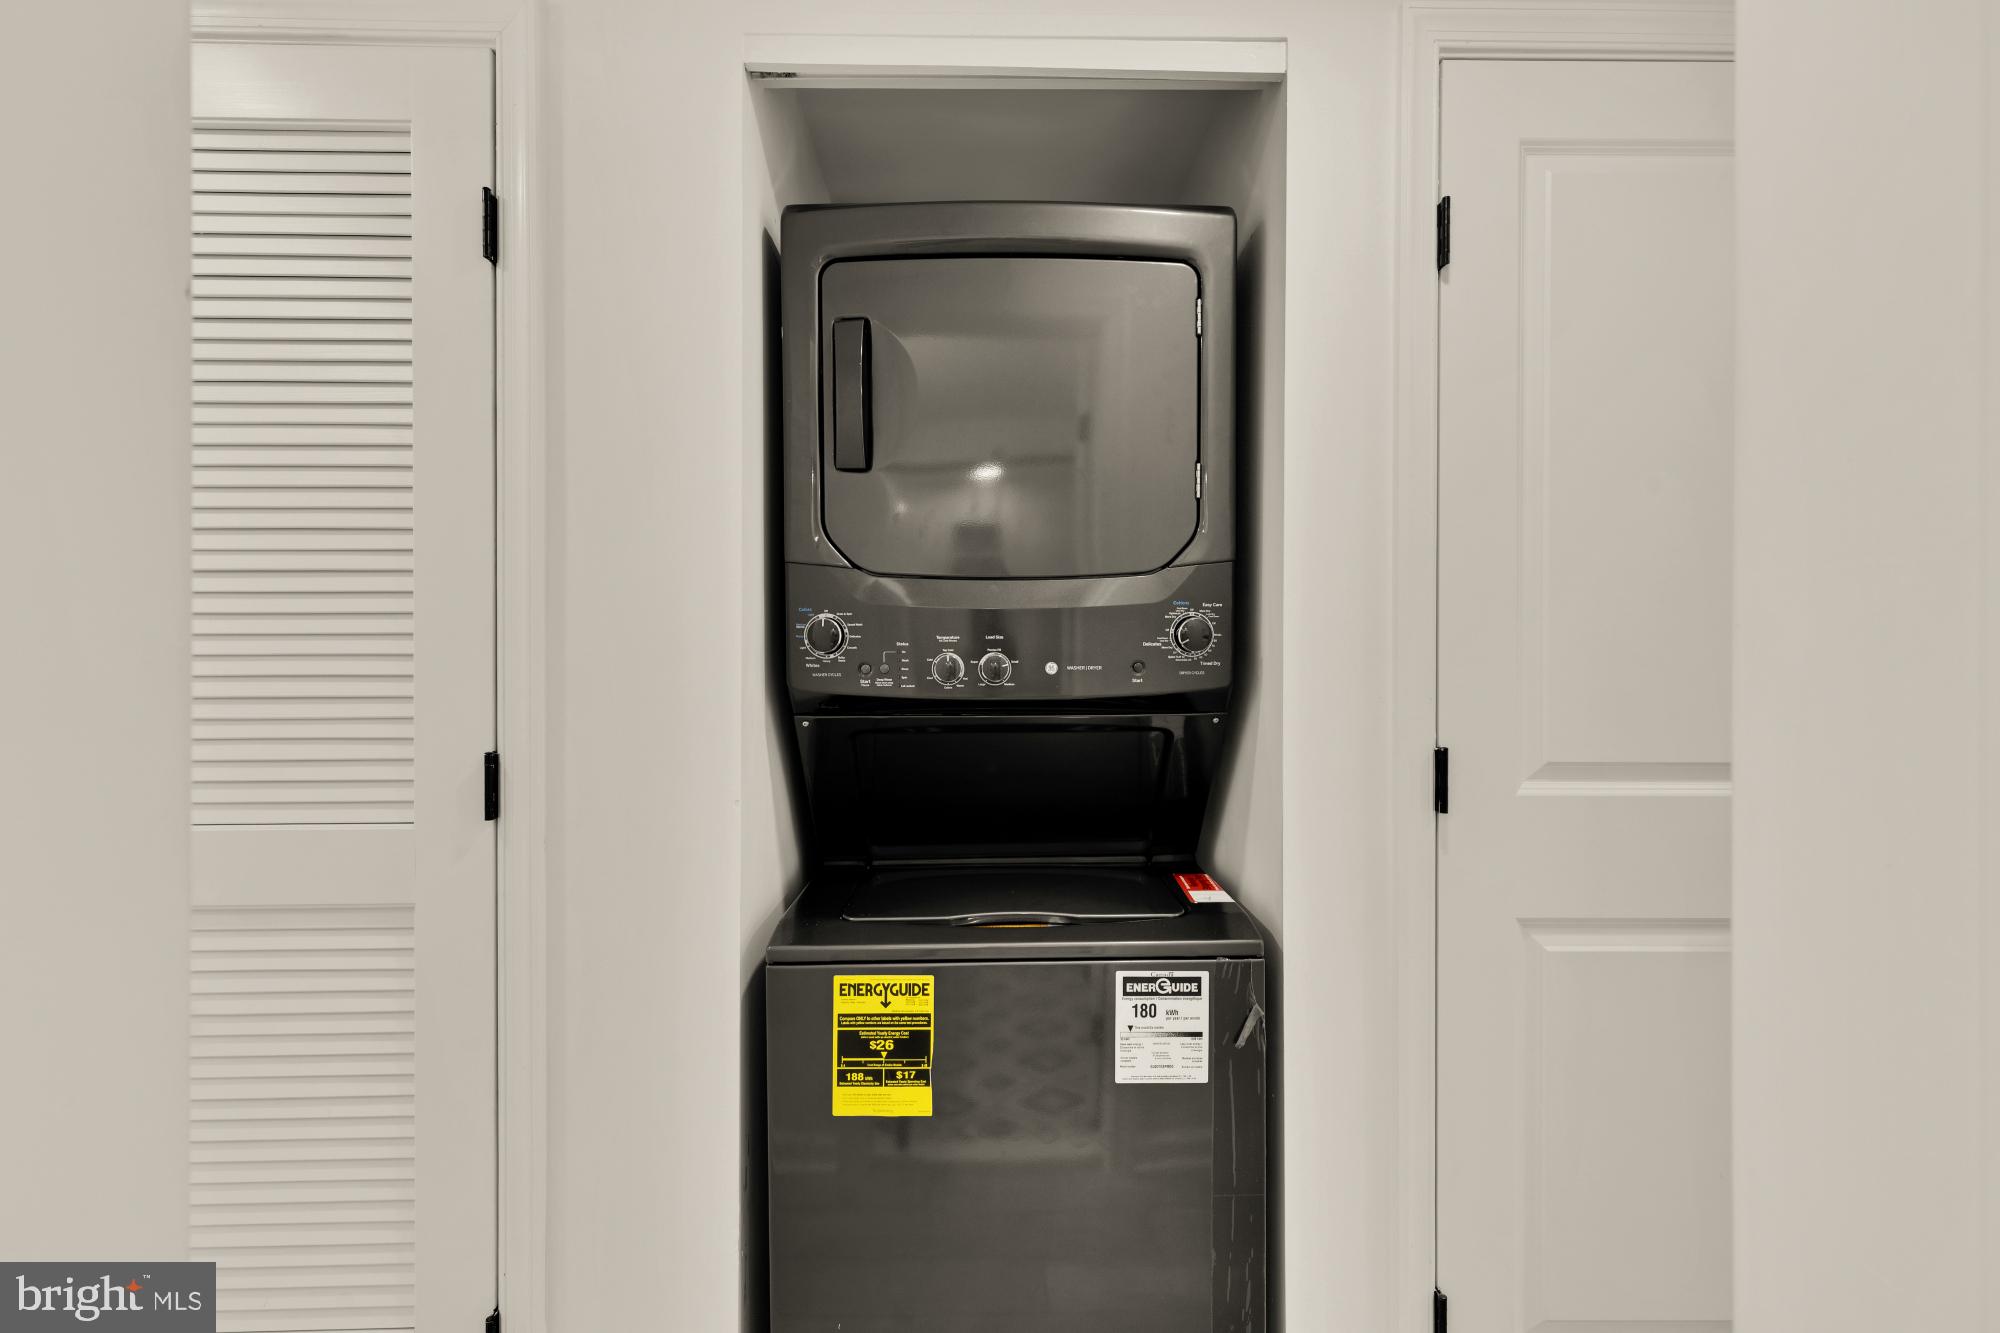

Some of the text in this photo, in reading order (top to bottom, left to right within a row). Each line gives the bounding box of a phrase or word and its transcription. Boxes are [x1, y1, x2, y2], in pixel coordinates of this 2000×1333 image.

[840, 983, 930, 996] ENERGYGUIDE
[1126, 978, 1198, 994] ENERGUIDE
[1132, 1004, 1156, 1018] 180
[869, 1040, 894, 1050] $26
[896, 1071, 915, 1079] $17
